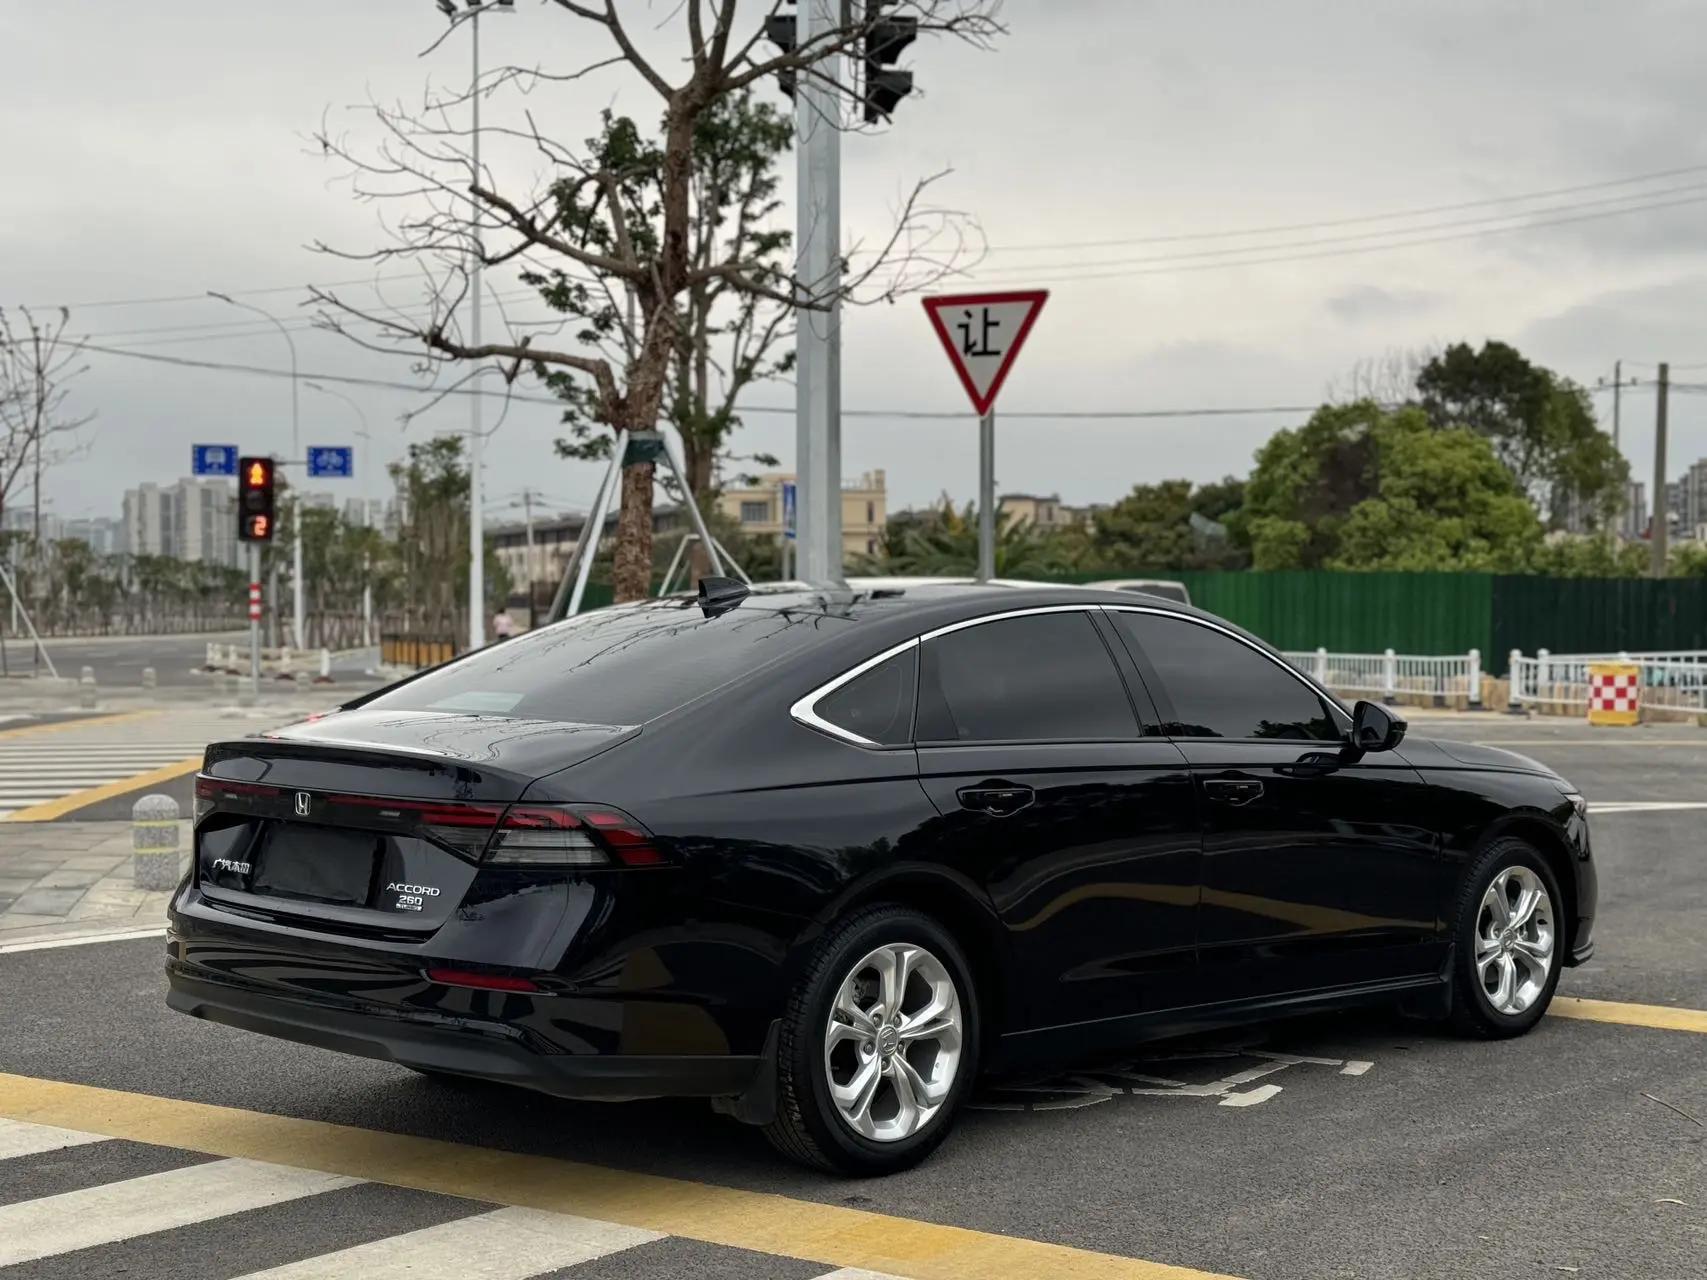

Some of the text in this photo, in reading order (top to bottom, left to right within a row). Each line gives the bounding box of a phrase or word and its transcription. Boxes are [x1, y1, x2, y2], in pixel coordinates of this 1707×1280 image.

[957, 307, 1001, 357] 让
[254, 515, 267, 536] 2
[386, 882, 441, 897] ACCORD
[398, 895, 423, 906] 260
